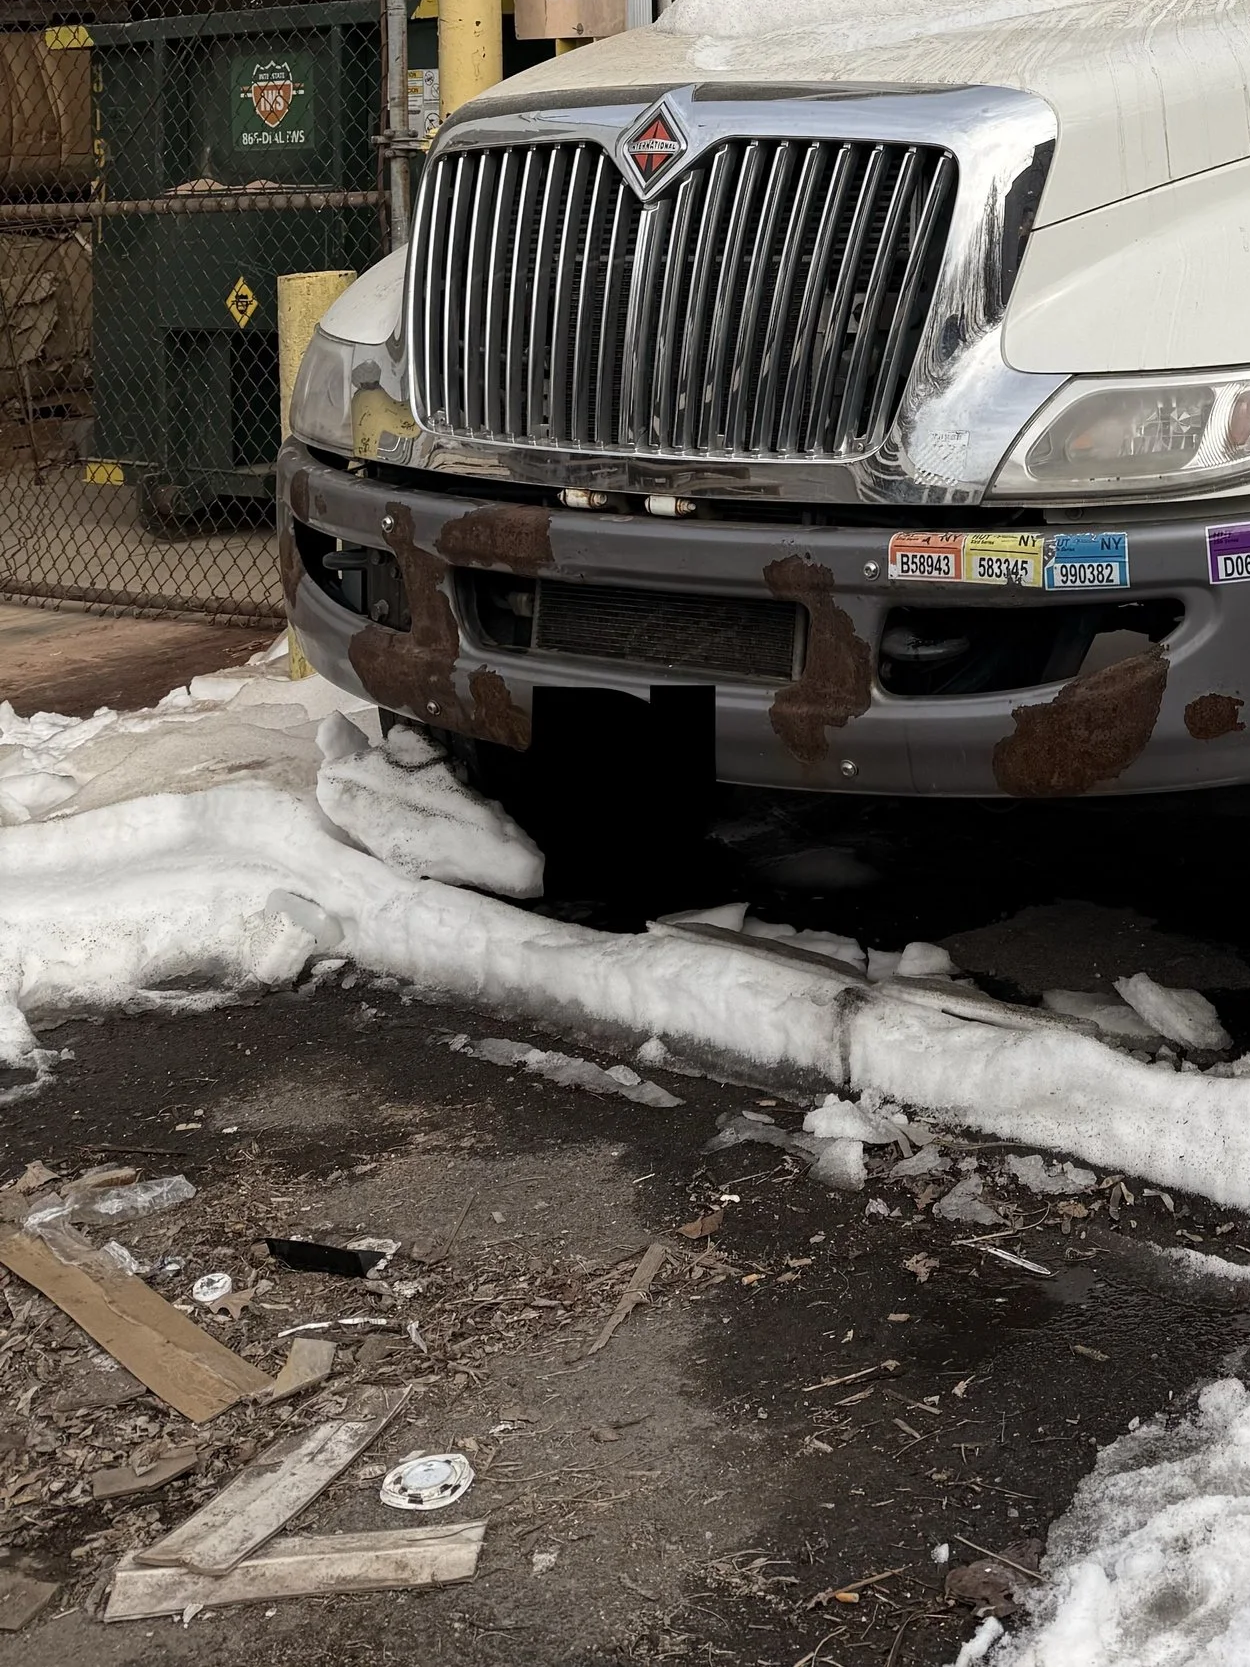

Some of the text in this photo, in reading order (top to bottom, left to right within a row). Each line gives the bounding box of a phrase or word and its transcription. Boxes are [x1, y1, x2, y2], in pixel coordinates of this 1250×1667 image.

[1018, 535, 1038, 547] NY
[1100, 537, 1122, 551] NY
[900, 553, 951, 576] B58943
[978, 557, 1029, 579] 583345
[1060, 563, 1115, 585] 990382
